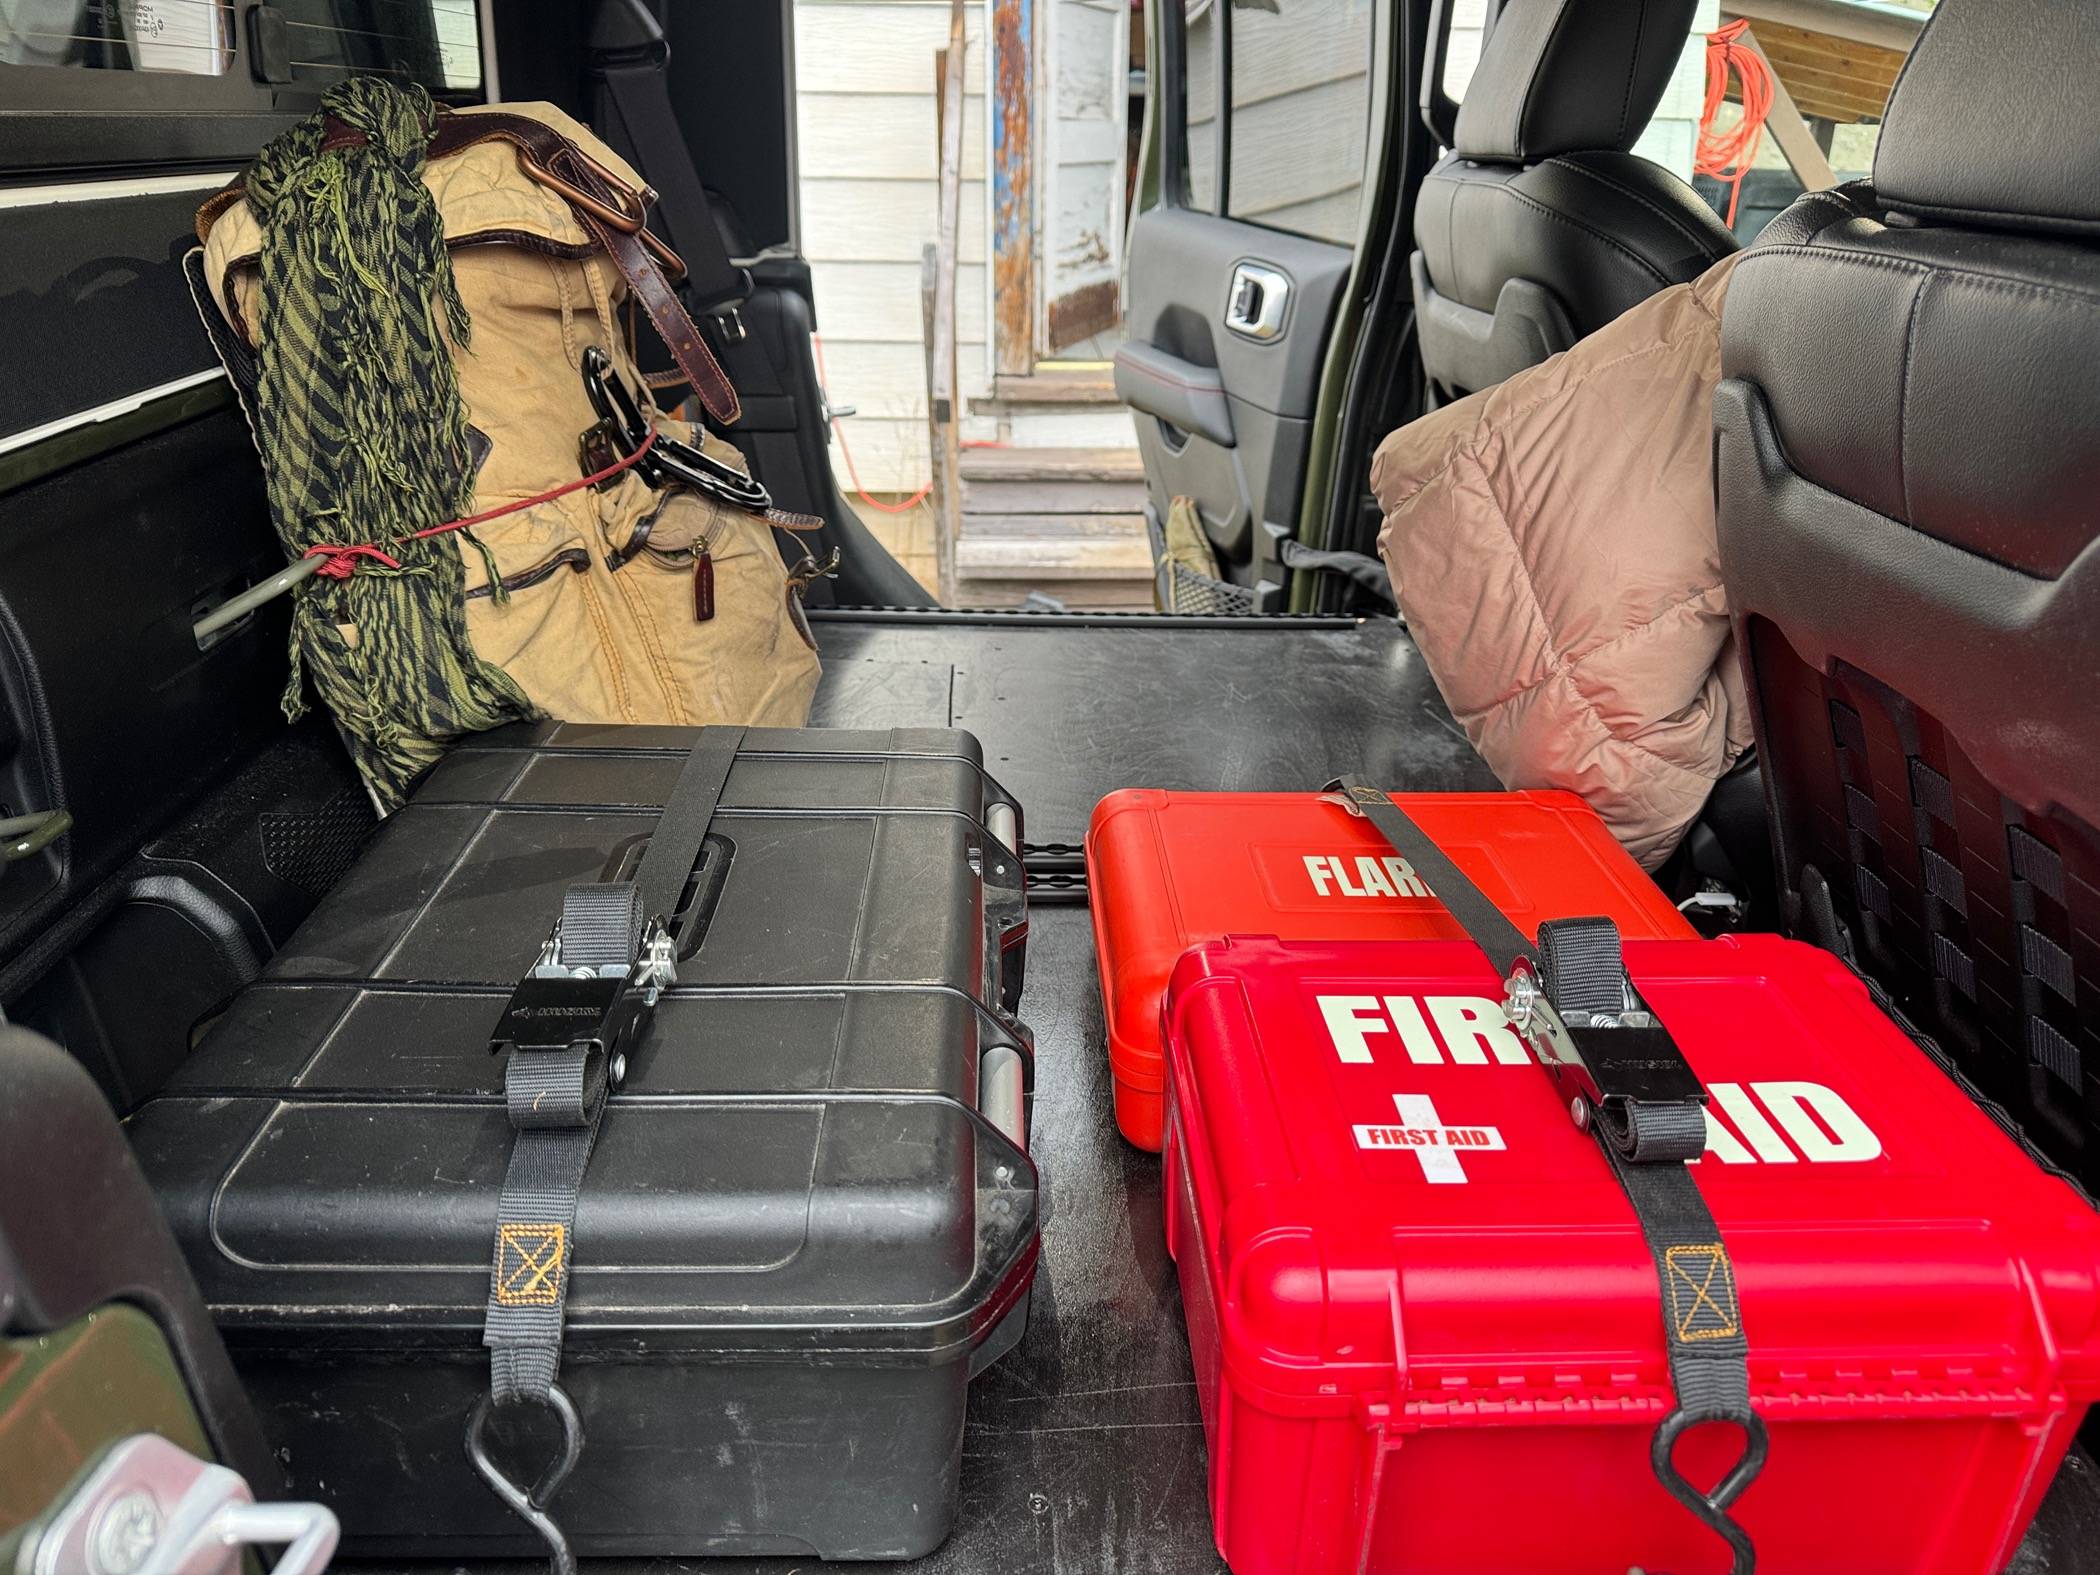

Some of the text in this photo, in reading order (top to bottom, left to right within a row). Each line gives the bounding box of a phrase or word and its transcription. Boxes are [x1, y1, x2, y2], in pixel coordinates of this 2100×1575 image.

[1302, 856, 1438, 897] FLAR
[1316, 996, 1532, 1064] FIR
[1367, 1129, 1491, 1146] FIRST AID
